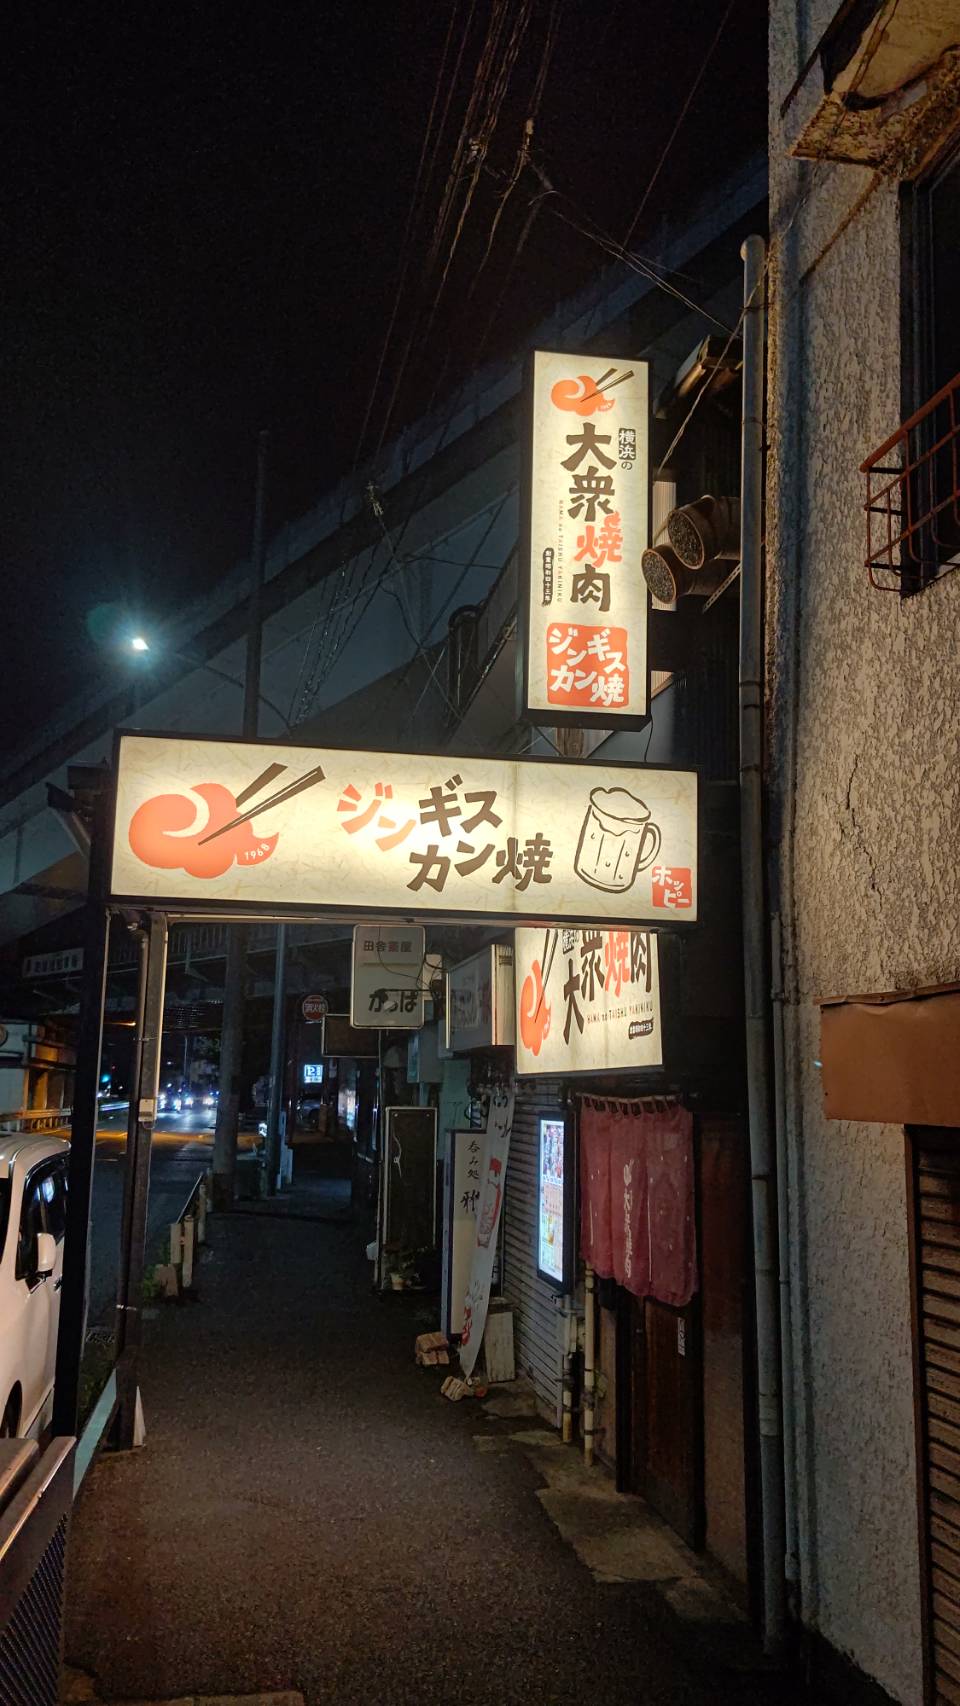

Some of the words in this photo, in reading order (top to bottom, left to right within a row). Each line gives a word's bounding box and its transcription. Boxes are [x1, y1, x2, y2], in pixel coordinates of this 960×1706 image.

[619, 428, 636, 471] 横浜の
[560, 422, 623, 612] 大衆焼肉
[244, 843, 270, 861] 1968
[467, 1140, 480, 1180] 呑み処
